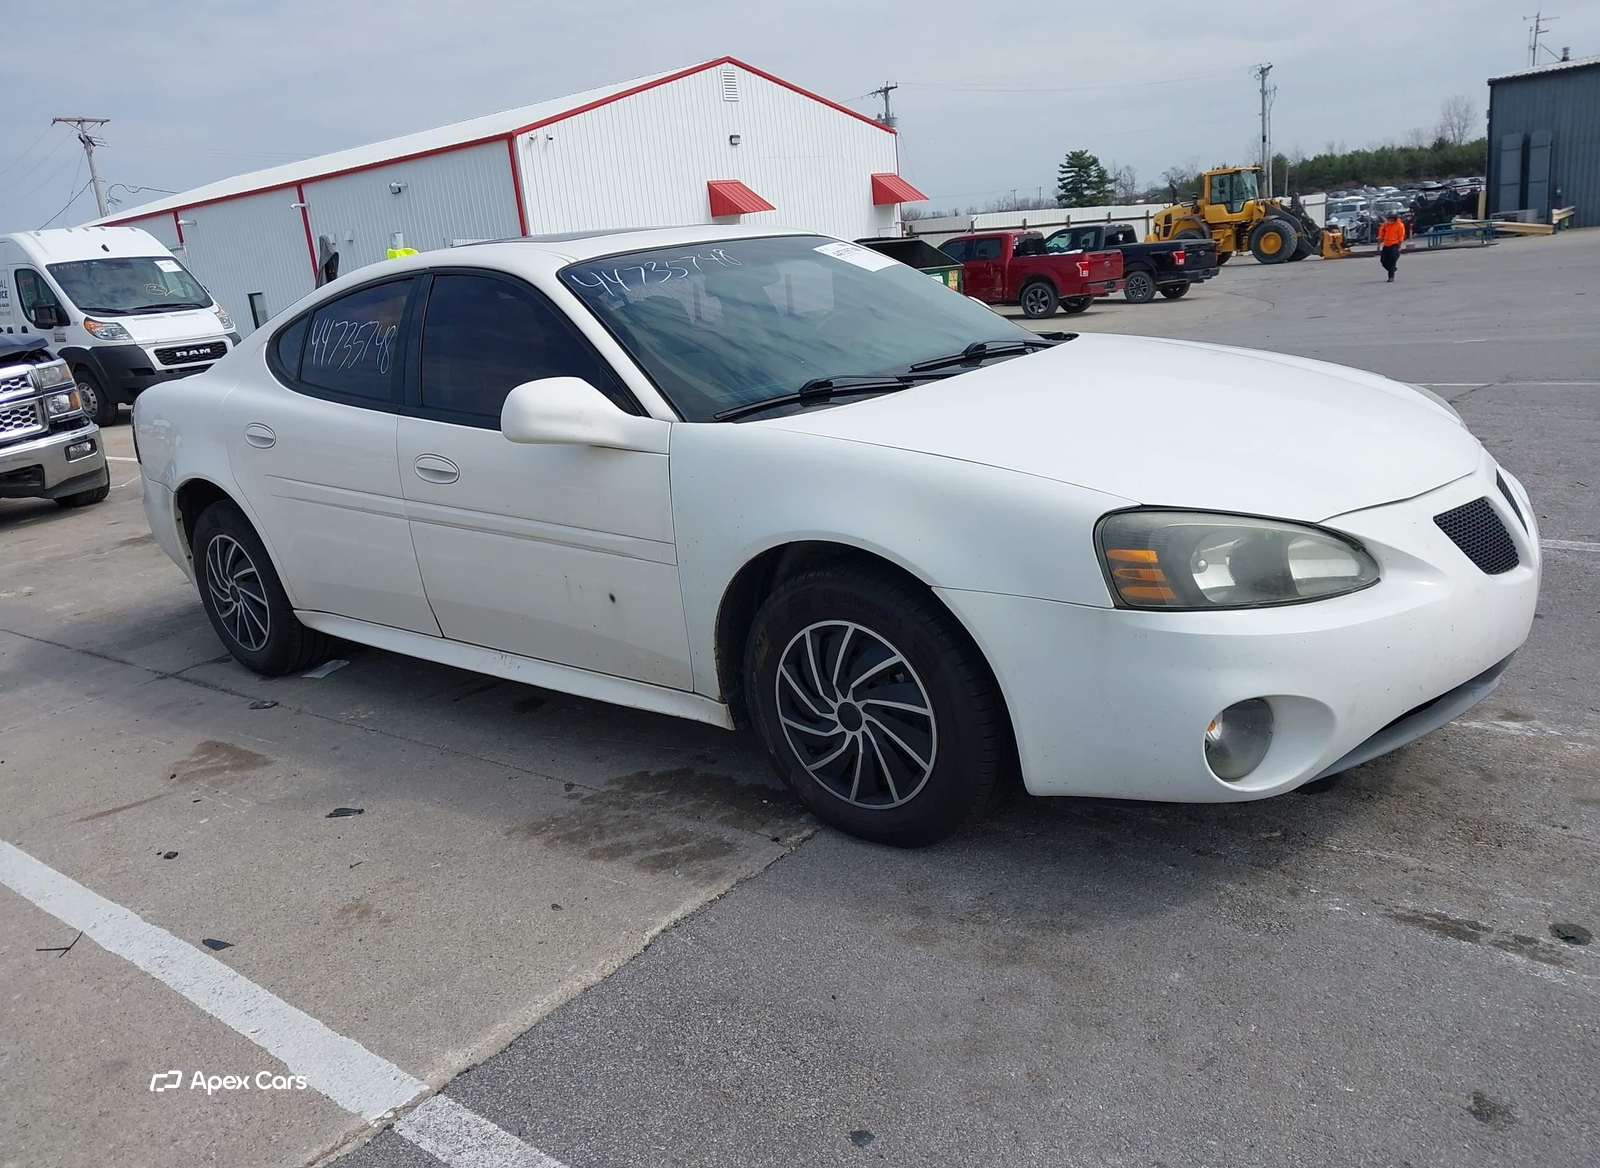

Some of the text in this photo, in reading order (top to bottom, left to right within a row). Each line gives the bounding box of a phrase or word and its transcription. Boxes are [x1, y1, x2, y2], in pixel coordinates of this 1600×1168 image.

[571, 248, 743, 297] 44735748
[175, 347, 211, 358] RAM
[311, 317, 397, 374] 44735748
